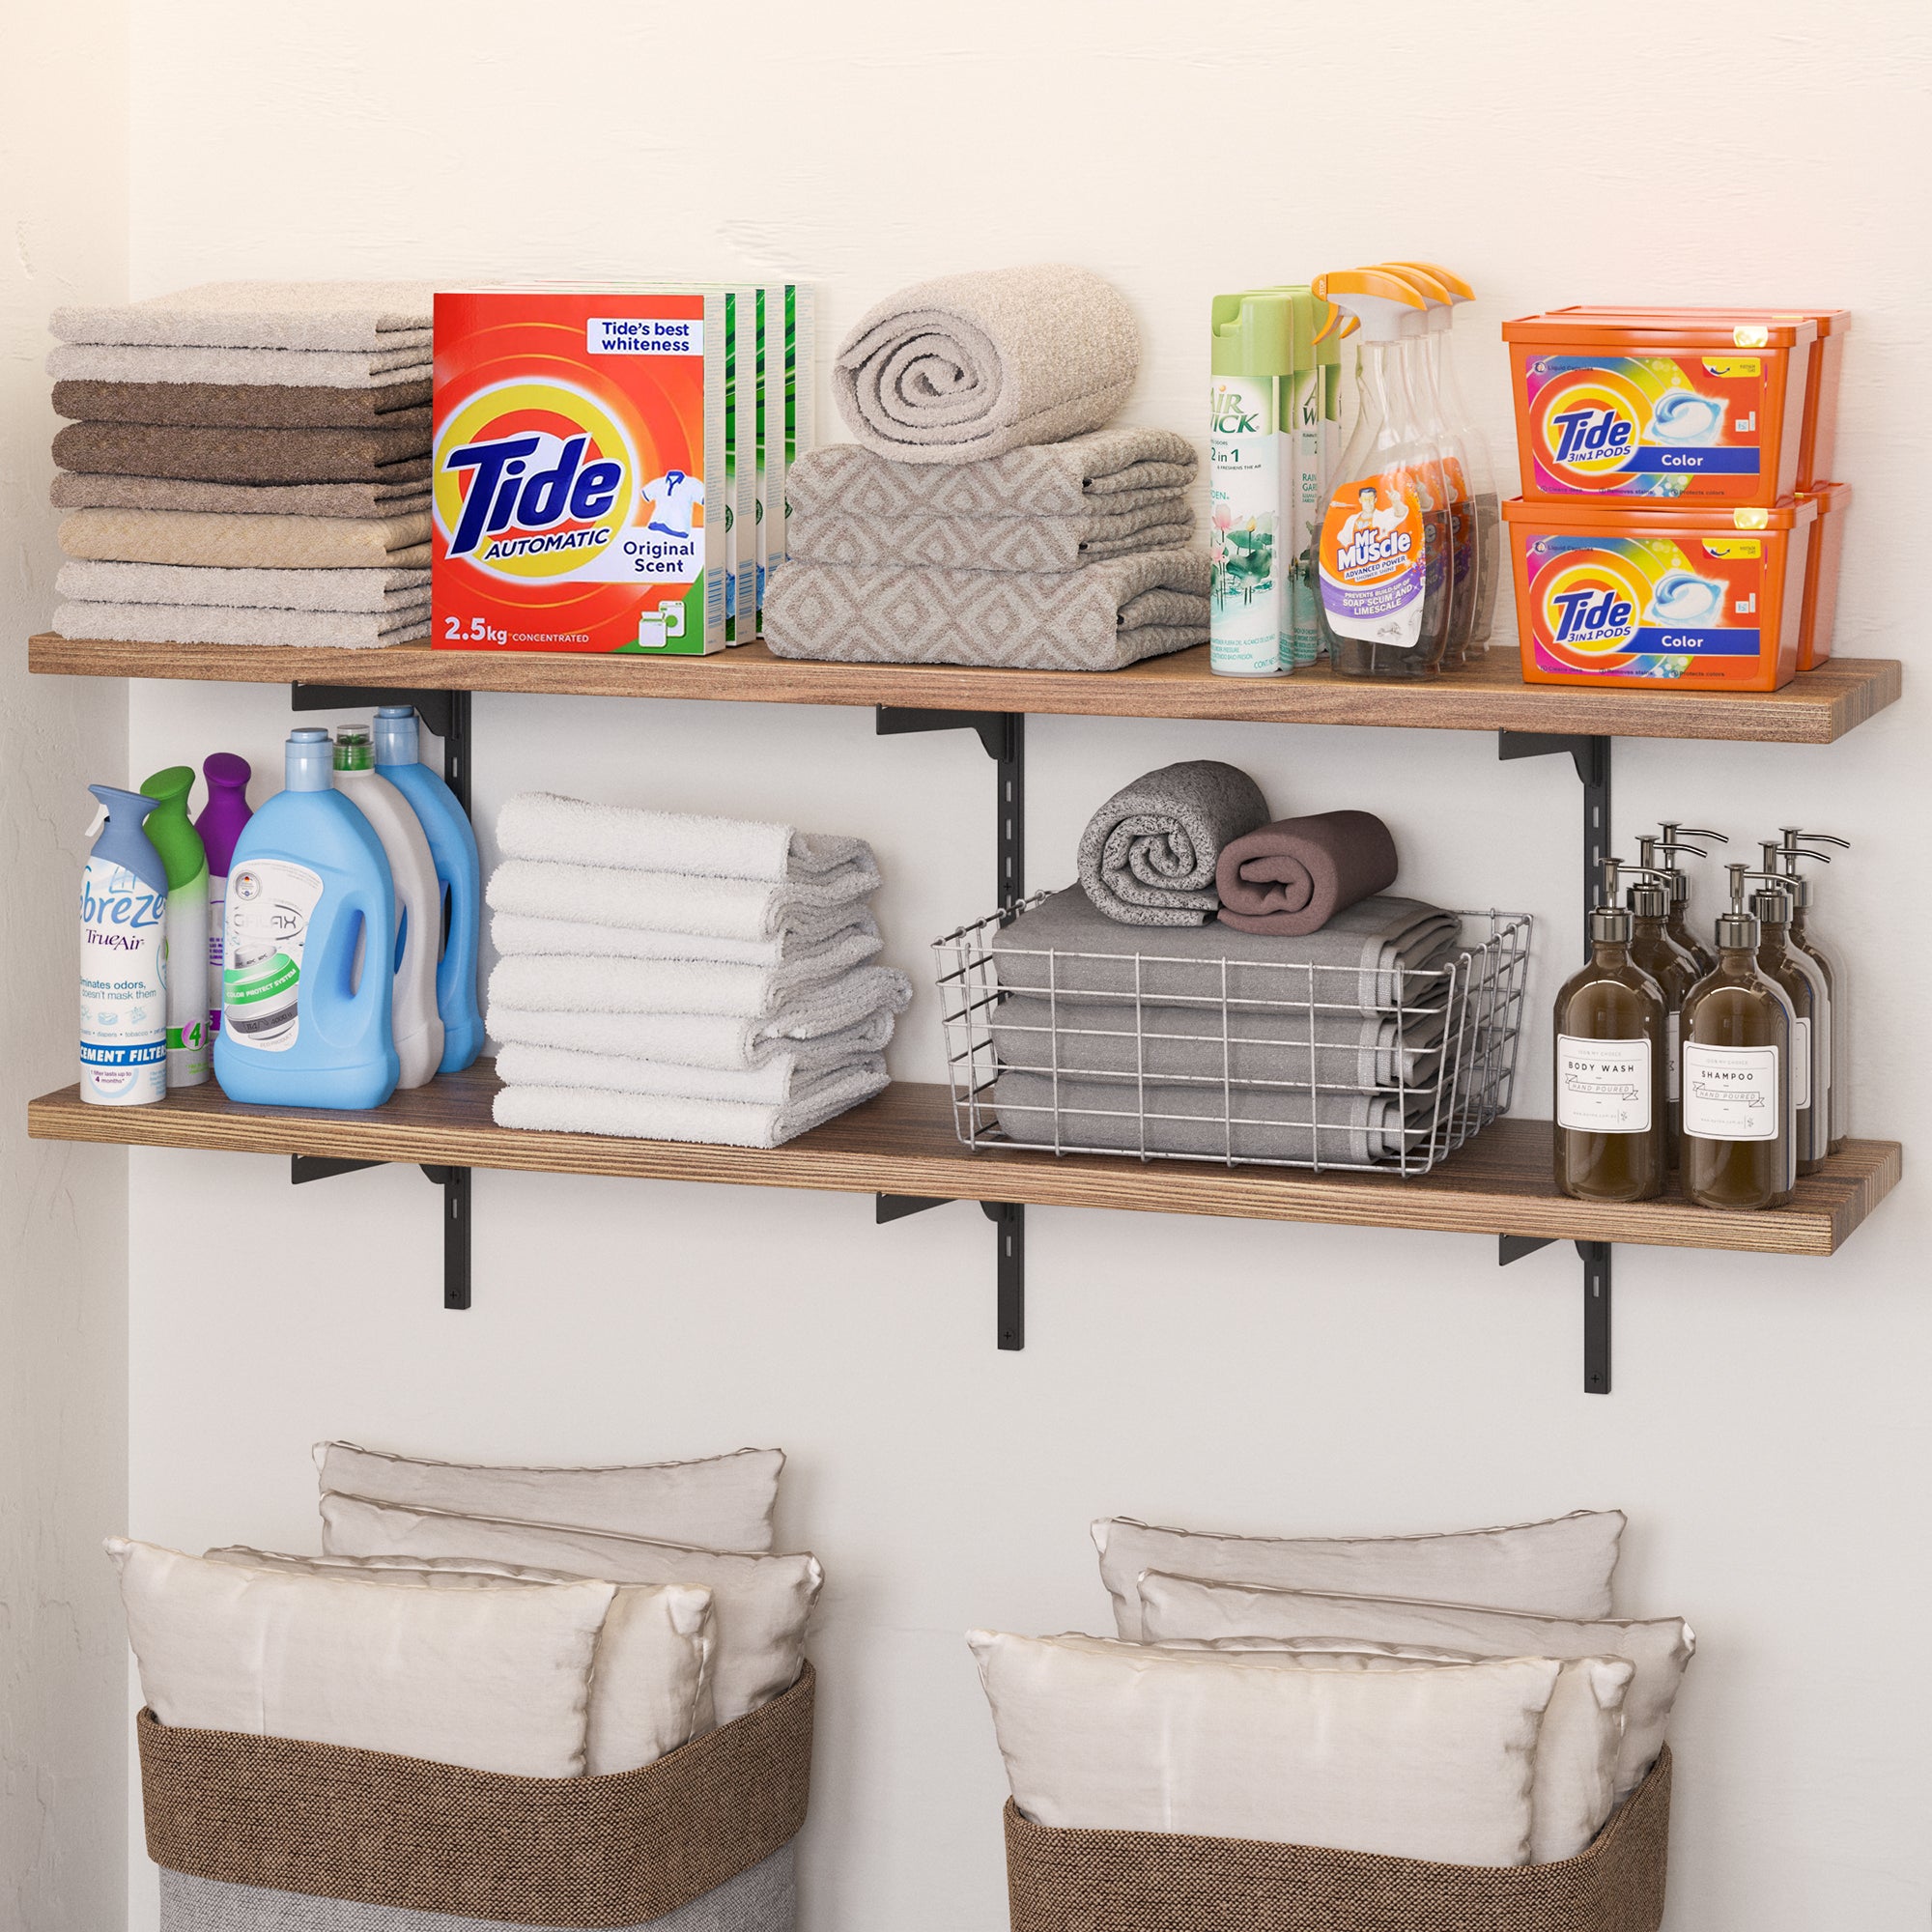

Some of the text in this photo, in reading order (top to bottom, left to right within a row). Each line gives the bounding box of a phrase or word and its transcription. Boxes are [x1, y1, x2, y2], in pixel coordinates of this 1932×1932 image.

[654, 323, 690, 336] best
[602, 337, 690, 352] whiteness
[1553, 411, 1632, 462] Tide
[1217, 452, 1228, 462] in
[1231, 448, 1238, 462] 1
[1568, 446, 1631, 463] 3IN1 PODS
[1661, 454, 1704, 467] Color
[445, 435, 622, 556] Tide
[485, 528, 611, 560] AUTOMATIC
[1354, 528, 1378, 548] Mr
[623, 541, 695, 559] Original
[1338, 531, 1411, 571] Muscle
[634, 559, 685, 573] Scent
[1346, 555, 1406, 579] ADVANCED POWER
[1367, 593, 1393, 606] SCUM
[1395, 584, 1413, 598] AND
[1376, 582, 1402, 596] BUILD-UP
[1353, 598, 1403, 615] LIMESCALE
[1553, 590, 1632, 642] Tide
[512, 633, 589, 643] CONCENTRATED
[1568, 626, 1631, 642] 3IN1 PODS
[1661, 635, 1704, 648] Color
[246, 982, 274, 997] PROTECT
[274, 969, 297, 986] SYSTEM
[135, 989, 156, 999] them
[1568, 1062, 1595, 1071] BODY
[1701, 1070, 1753, 1080] SHAMPOO
